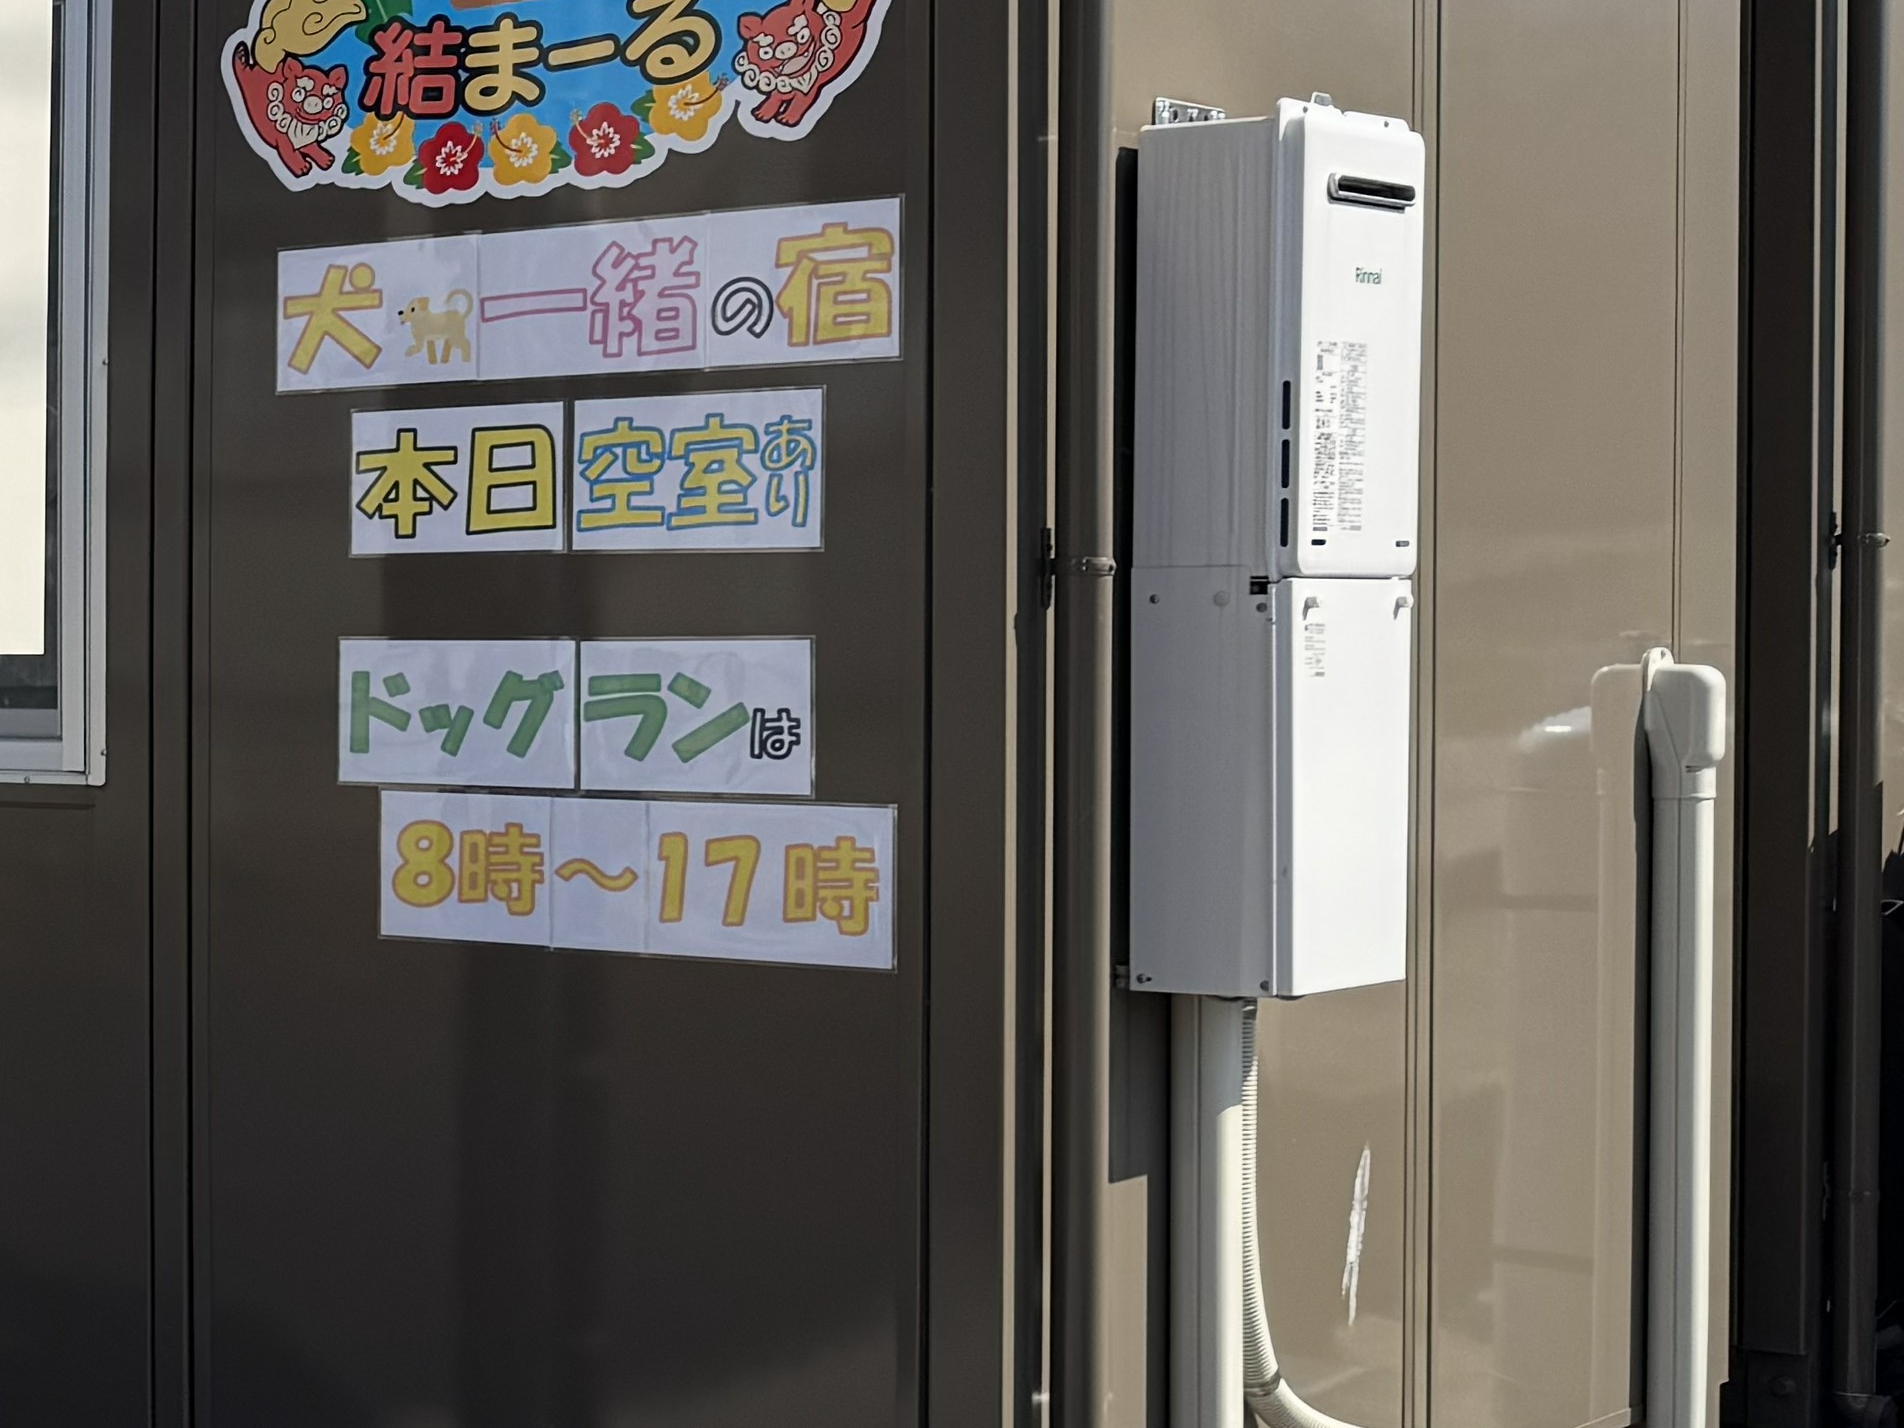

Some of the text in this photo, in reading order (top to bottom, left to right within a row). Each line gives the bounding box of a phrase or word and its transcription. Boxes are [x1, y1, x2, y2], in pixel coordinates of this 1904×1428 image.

[348, 670, 802, 763] ドッグランは
